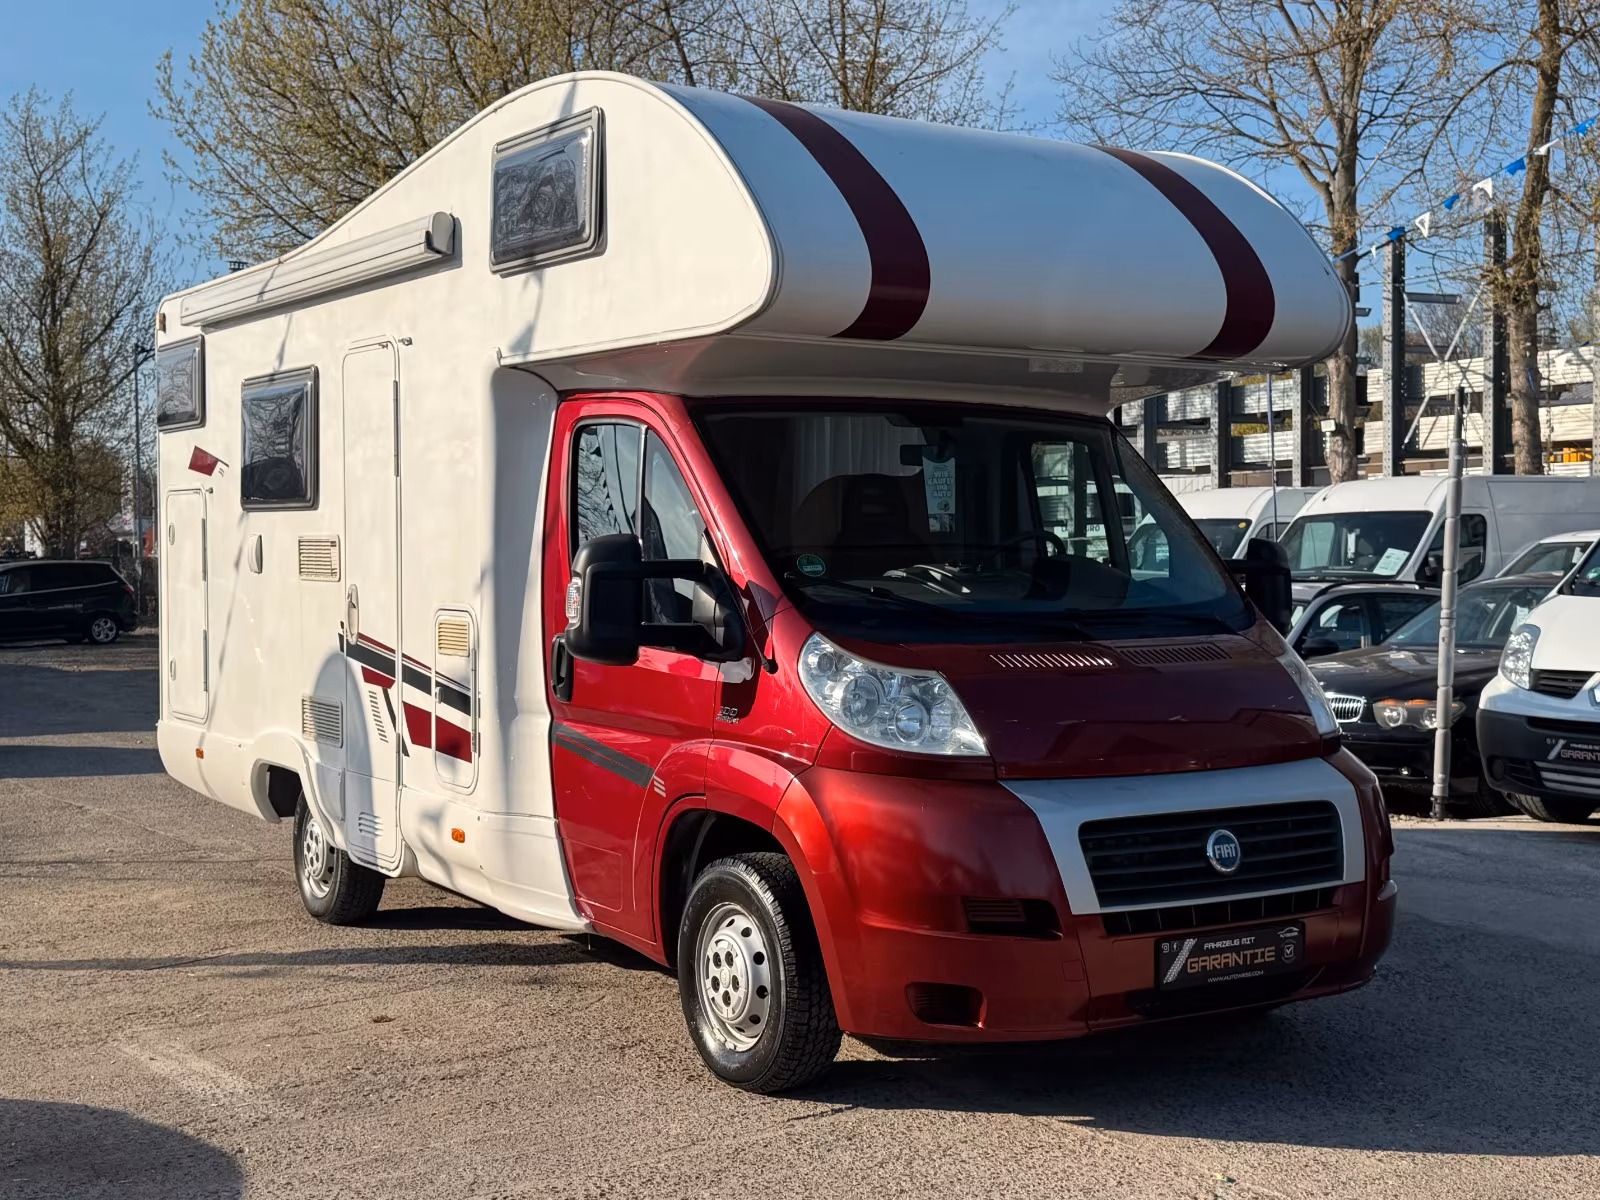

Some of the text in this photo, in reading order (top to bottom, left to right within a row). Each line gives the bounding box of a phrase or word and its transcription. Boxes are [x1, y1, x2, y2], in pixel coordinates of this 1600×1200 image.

[1214, 843, 1236, 859] FIAT
[1204, 936, 1256, 950] FAHRZEUG MIT
[1187, 946, 1276, 973] GARANTIE
